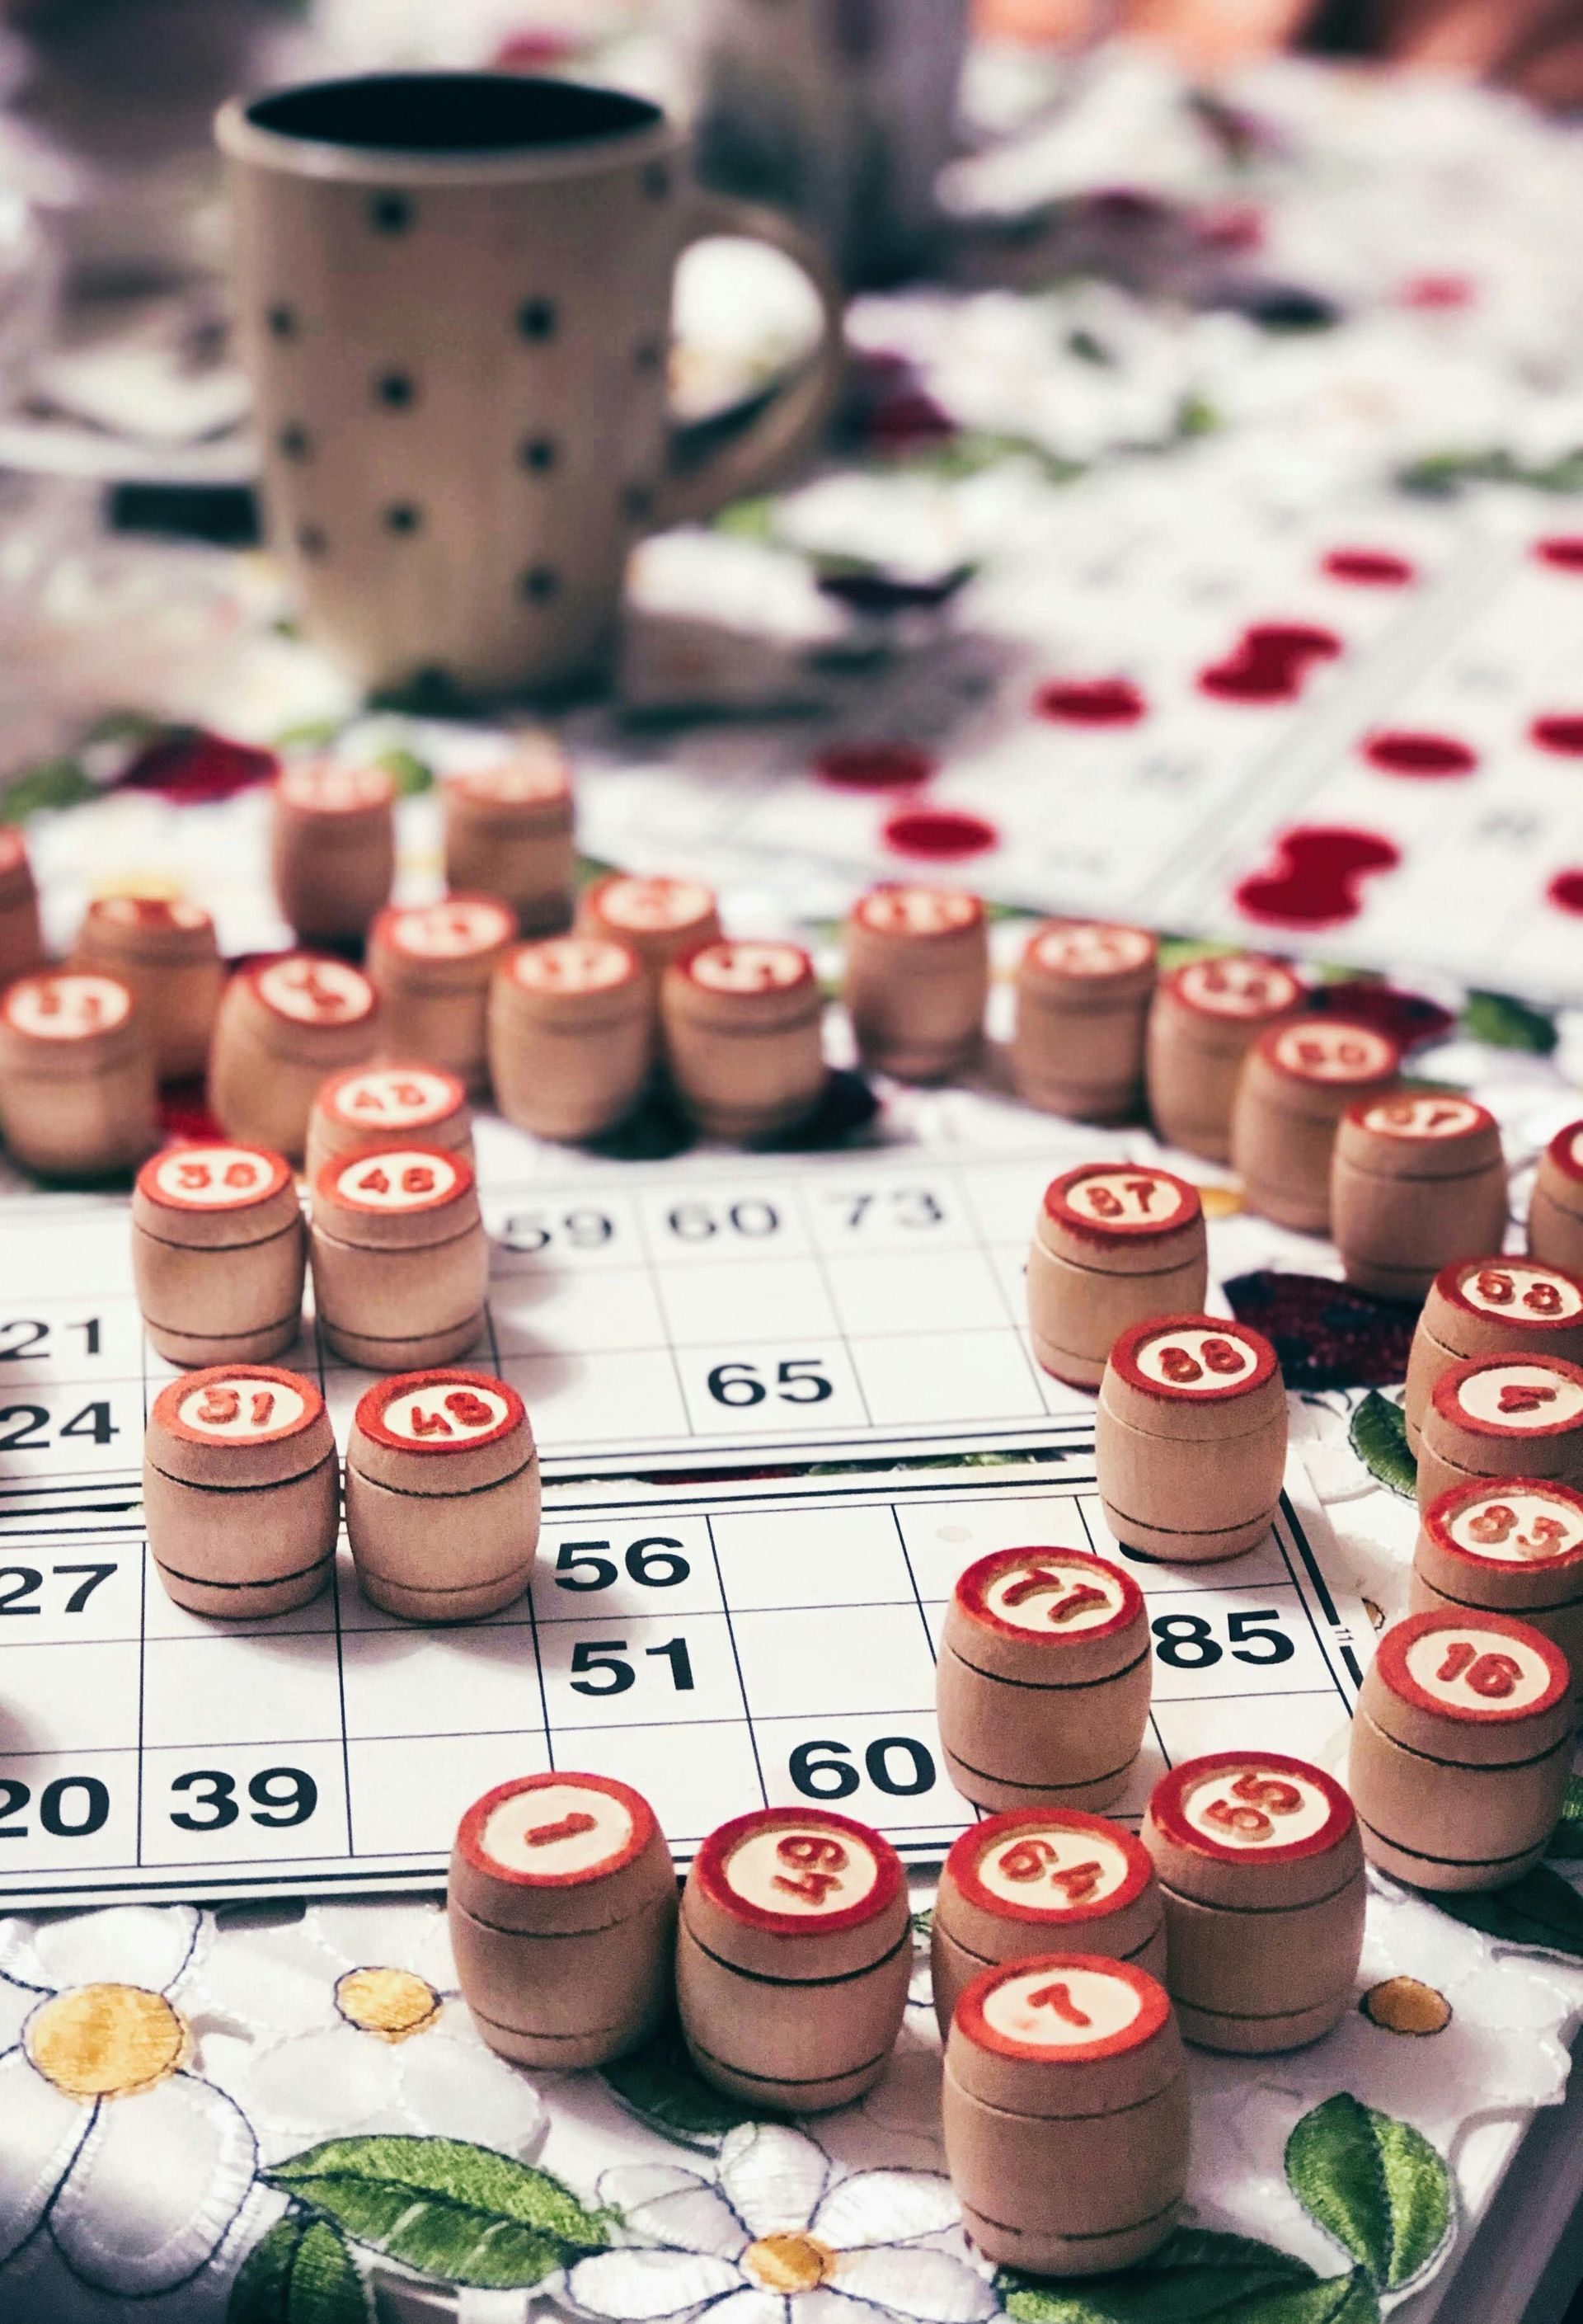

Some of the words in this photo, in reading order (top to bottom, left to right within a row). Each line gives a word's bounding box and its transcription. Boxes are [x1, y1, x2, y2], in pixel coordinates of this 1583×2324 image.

[667, 1199, 780, 1240] 60
[828, 1189, 945, 1230] 73
[1086, 1180, 1156, 1217] 87
[500, 1207, 614, 1254] 59
[0, 1318, 100, 1360] 21
[707, 1359, 833, 1407] 65
[0, 1400, 120, 1451] 24
[0, 1563, 118, 1616] 27
[554, 1536, 691, 1592] 56
[1002, 1568, 1111, 1624] 77
[1151, 1609, 1295, 1669] 85
[569, 1637, 695, 1696] 51
[1435, 1642, 1525, 1699] 16
[788, 1736, 937, 1799] 60
[169, 1767, 319, 1832] 39
[998, 1840, 1106, 1905] 64
[1027, 1983, 1092, 2027] 7
